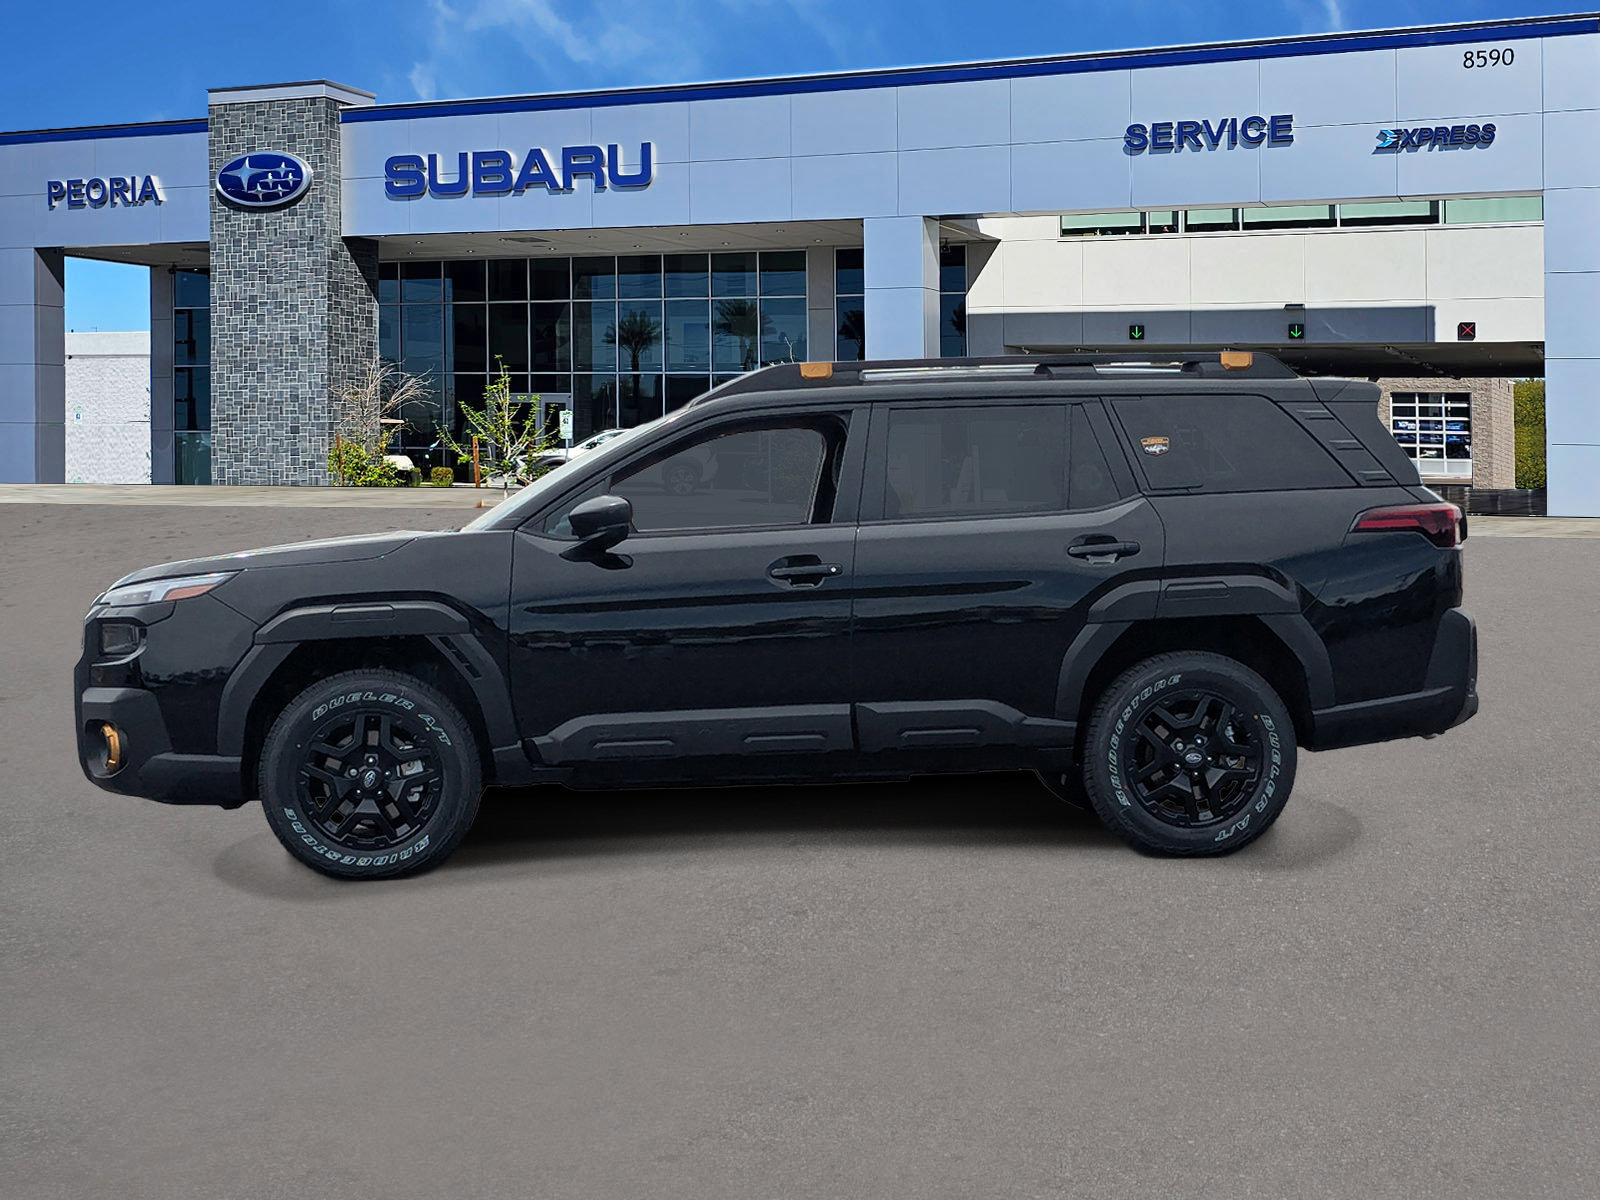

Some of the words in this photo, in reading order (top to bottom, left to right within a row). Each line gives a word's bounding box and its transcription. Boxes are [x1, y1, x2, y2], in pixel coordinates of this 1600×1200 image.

[1463, 48, 1514, 69] 8590
[1125, 115, 1294, 151] SERVICE
[1376, 123, 1497, 149] EXPRESS
[47, 175, 161, 209] PEORIA
[384, 142, 653, 198] SUBARU
[312, 692, 415, 720] DUELER
[418, 713, 452, 746] A/T
[1108, 674, 1181, 806] BRIDGESTONE
[1260, 714, 1281, 813] DUELER
[284, 807, 431, 866] BRIDGESTONE
[1214, 814, 1250, 841] A/T
